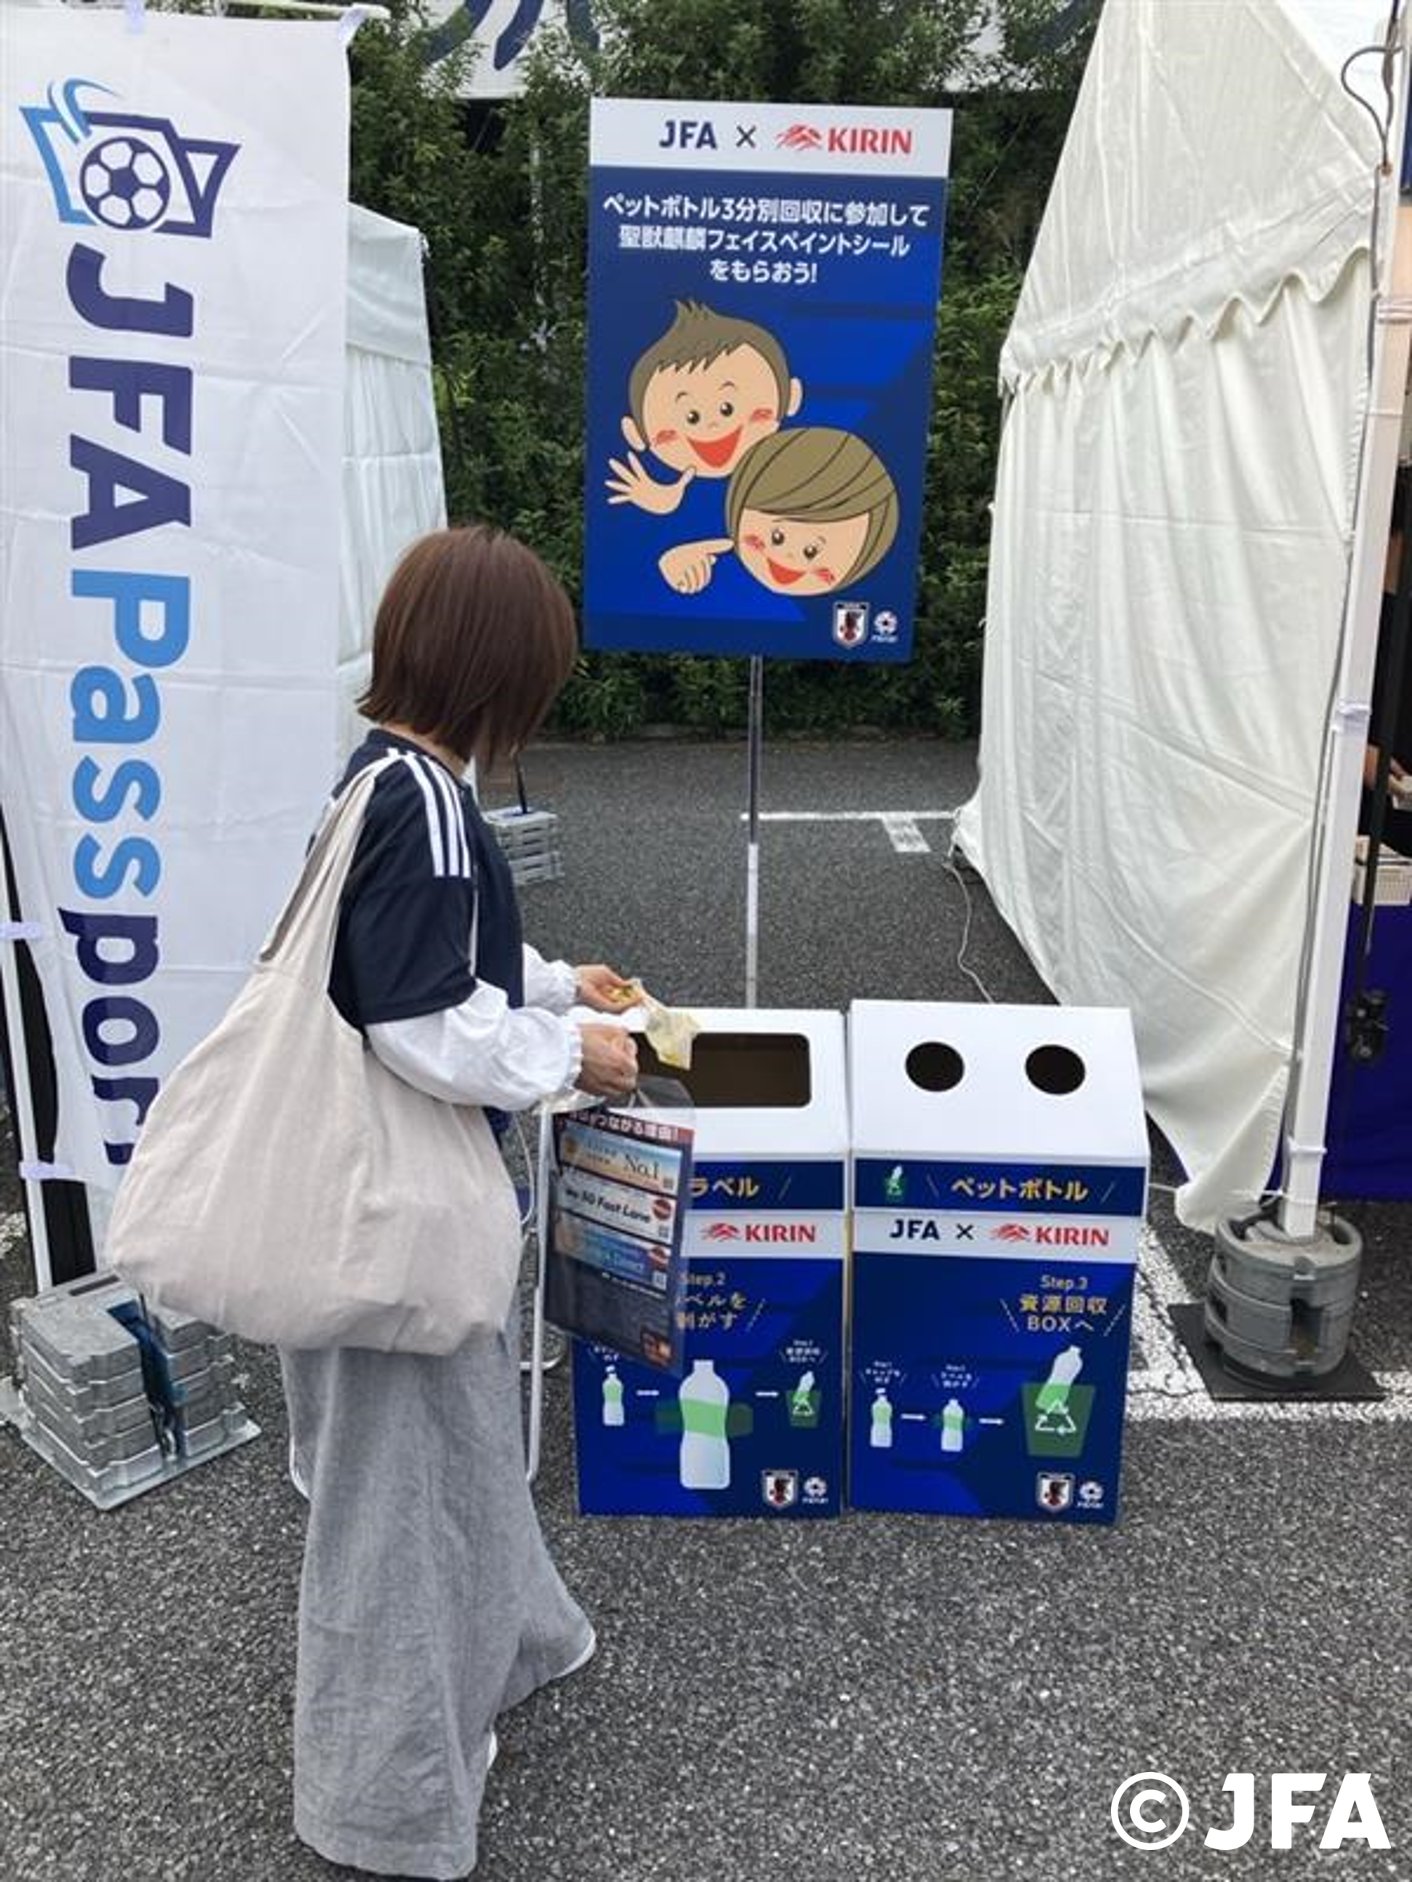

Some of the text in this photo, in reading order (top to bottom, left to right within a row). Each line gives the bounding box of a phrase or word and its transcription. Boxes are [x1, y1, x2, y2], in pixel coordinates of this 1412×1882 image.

[659, 120, 718, 150] JFA
[827, 127, 912, 154] KIRIN
[603, 193, 931, 228] ペットボトル3分別回収に参加して
[619, 224, 911, 257] 聖獣麒麟フェイスペイントシール
[951, 1176, 1089, 1201] ペットボトル
[745, 1224, 816, 1243] KIRIN
[889, 1218, 940, 1241] JFA
[1036, 1225, 1109, 1246] KIRIN
[1019, 1293, 1108, 1315] 資源回収
